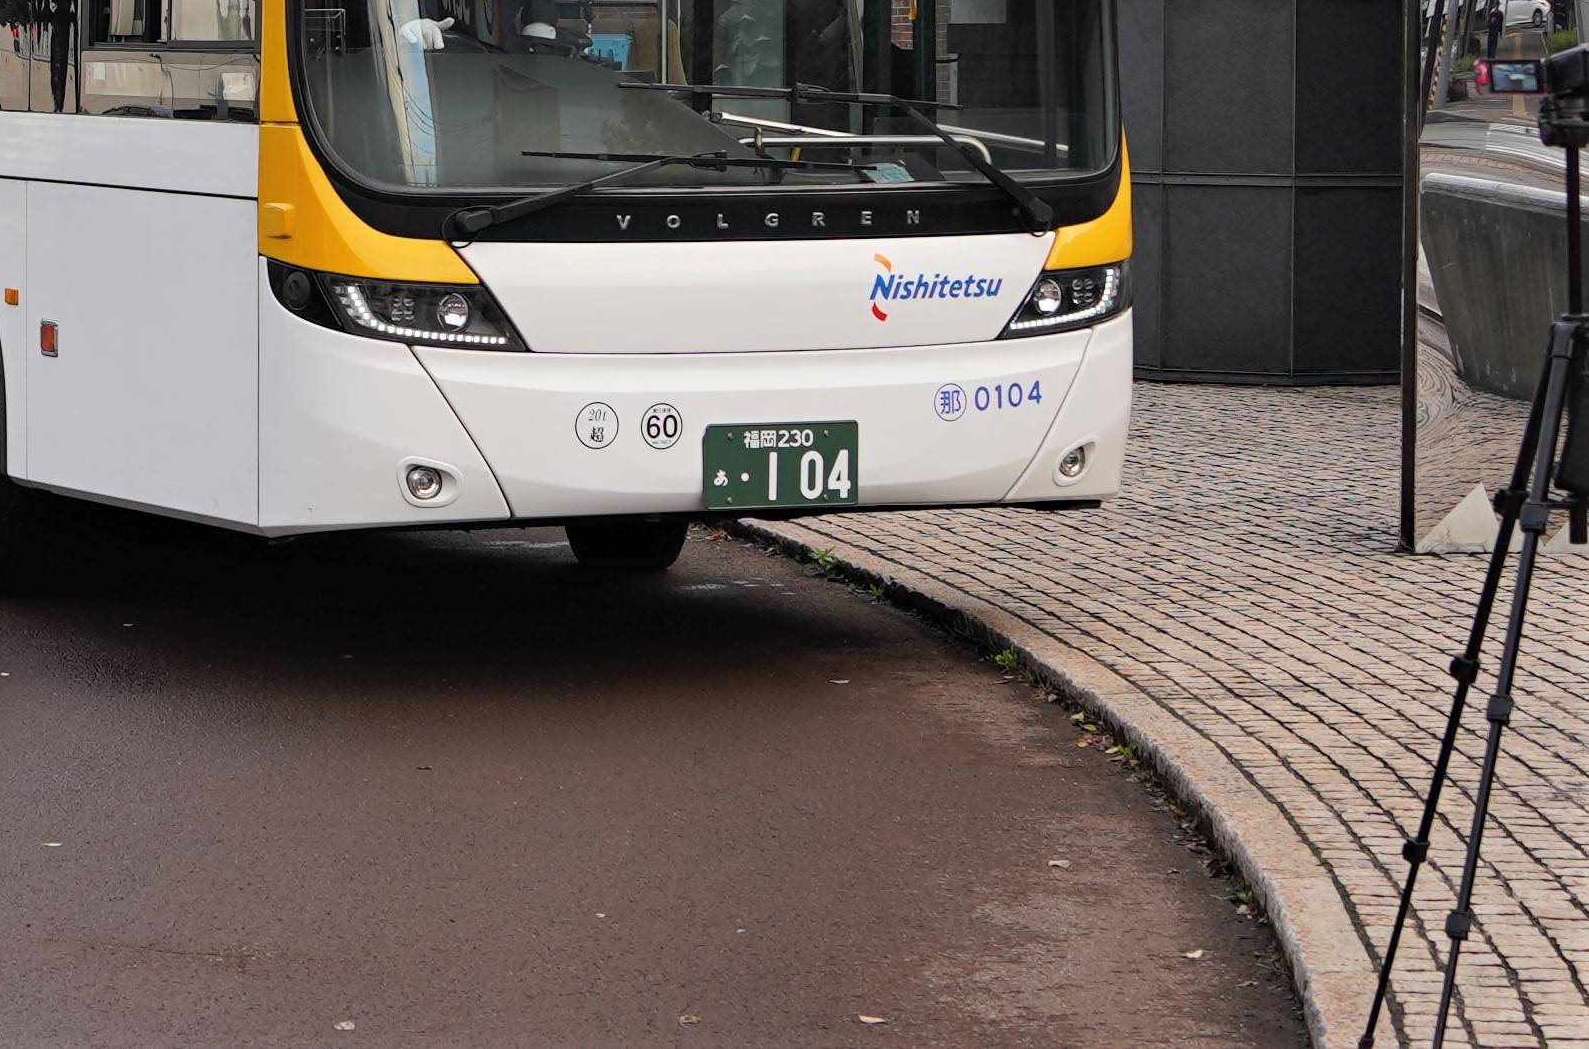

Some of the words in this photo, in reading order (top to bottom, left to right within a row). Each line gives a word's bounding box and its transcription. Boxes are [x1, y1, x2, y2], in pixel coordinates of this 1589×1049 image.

[616, 209, 921, 230] VOLGREN
[869, 273, 1003, 301] Nishitetsu
[974, 380, 1042, 411] 0104
[646, 414, 678, 439] 60
